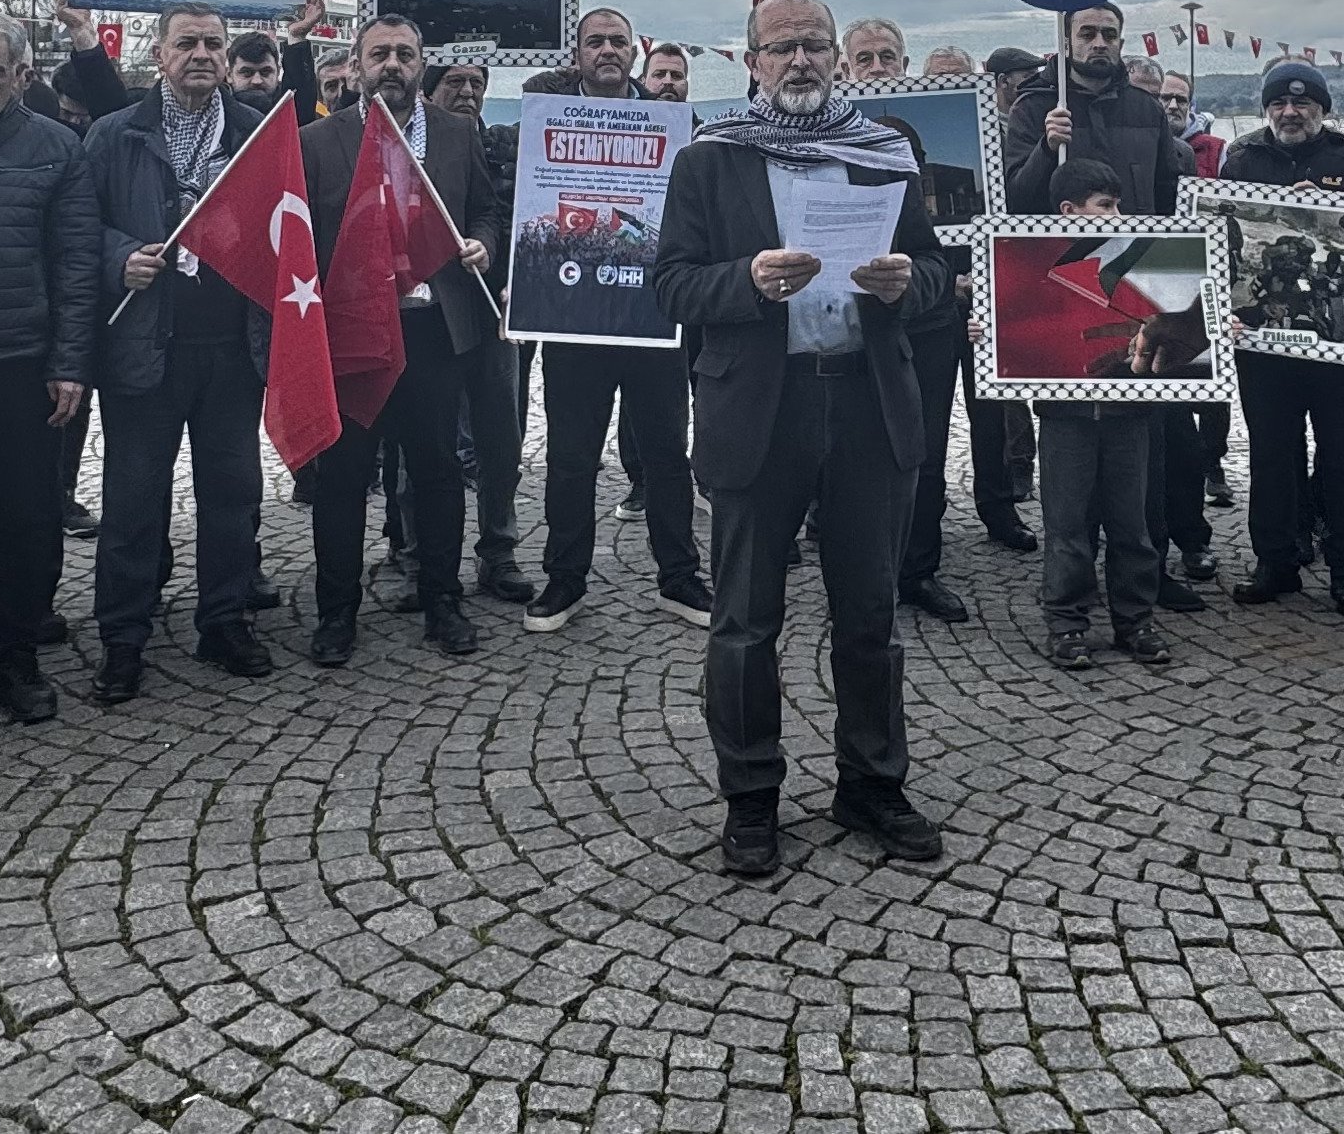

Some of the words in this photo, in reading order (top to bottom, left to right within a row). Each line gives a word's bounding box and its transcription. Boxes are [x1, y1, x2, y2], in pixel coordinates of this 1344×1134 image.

[452, 44, 488, 55] Gazze
[563, 105, 650, 122] COĞRAFYAMIZDA
[597, 121, 606, 130] VE
[549, 131, 659, 166] İSTEMİYORUZ!
[1203, 282, 1218, 335] Filistin
[1262, 330, 1313, 344] Filistin
